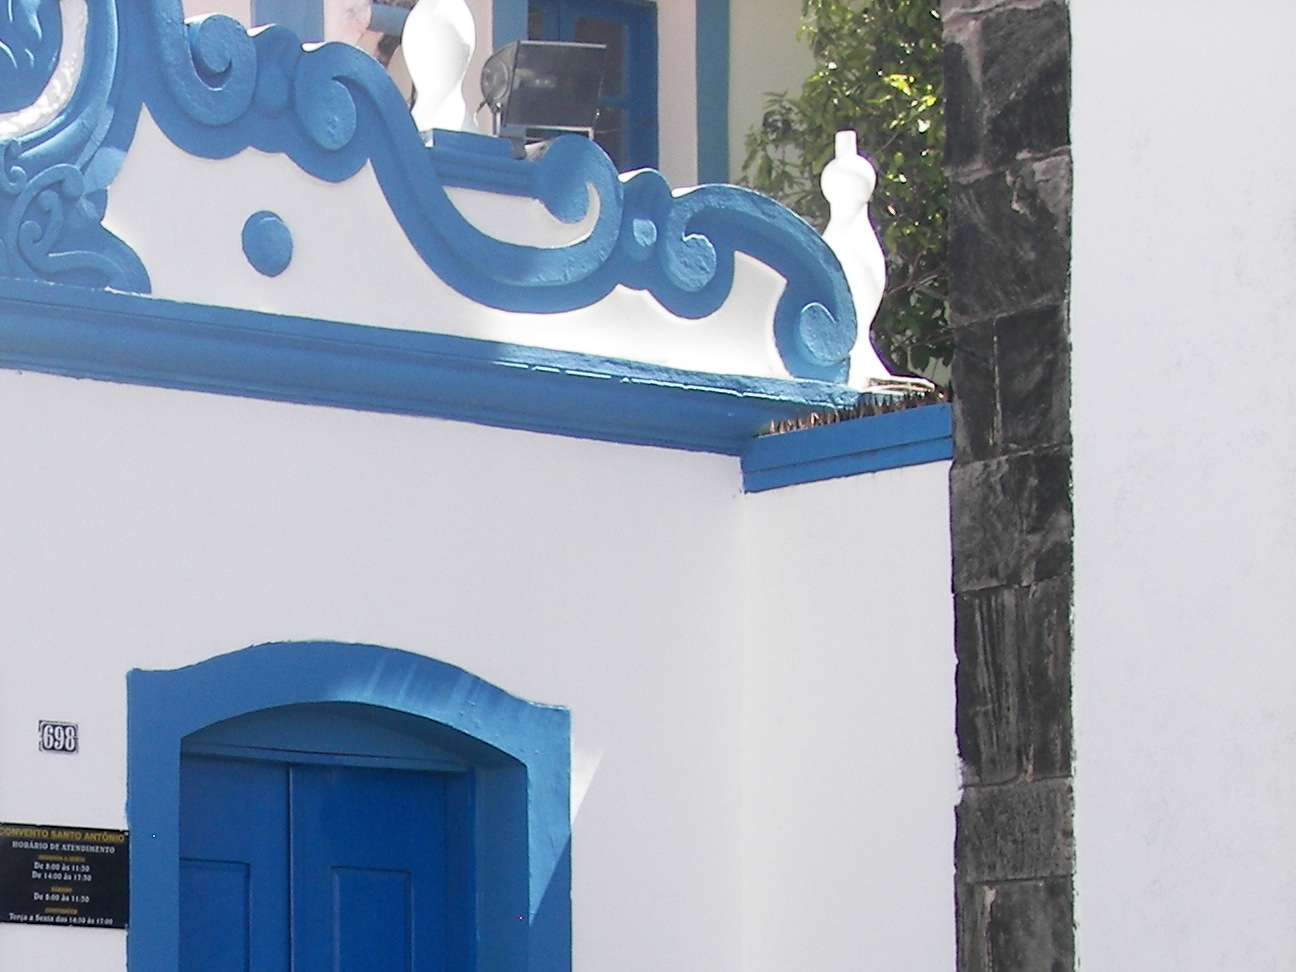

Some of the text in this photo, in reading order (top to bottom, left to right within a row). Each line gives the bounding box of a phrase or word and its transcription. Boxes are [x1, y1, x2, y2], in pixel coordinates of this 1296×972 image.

[43, 724, 75, 751] 698
[51, 830, 82, 840] SANTO
[12, 840, 115, 854] HORÁRIO DE ATENDIMENTO
[33, 861, 44, 870] De
[61, 862, 70, 872] às
[31, 870, 42, 879] De
[33, 892, 44, 901] De
[9, 912, 28, 922] Terça
[35, 914, 54, 922] Sexta
